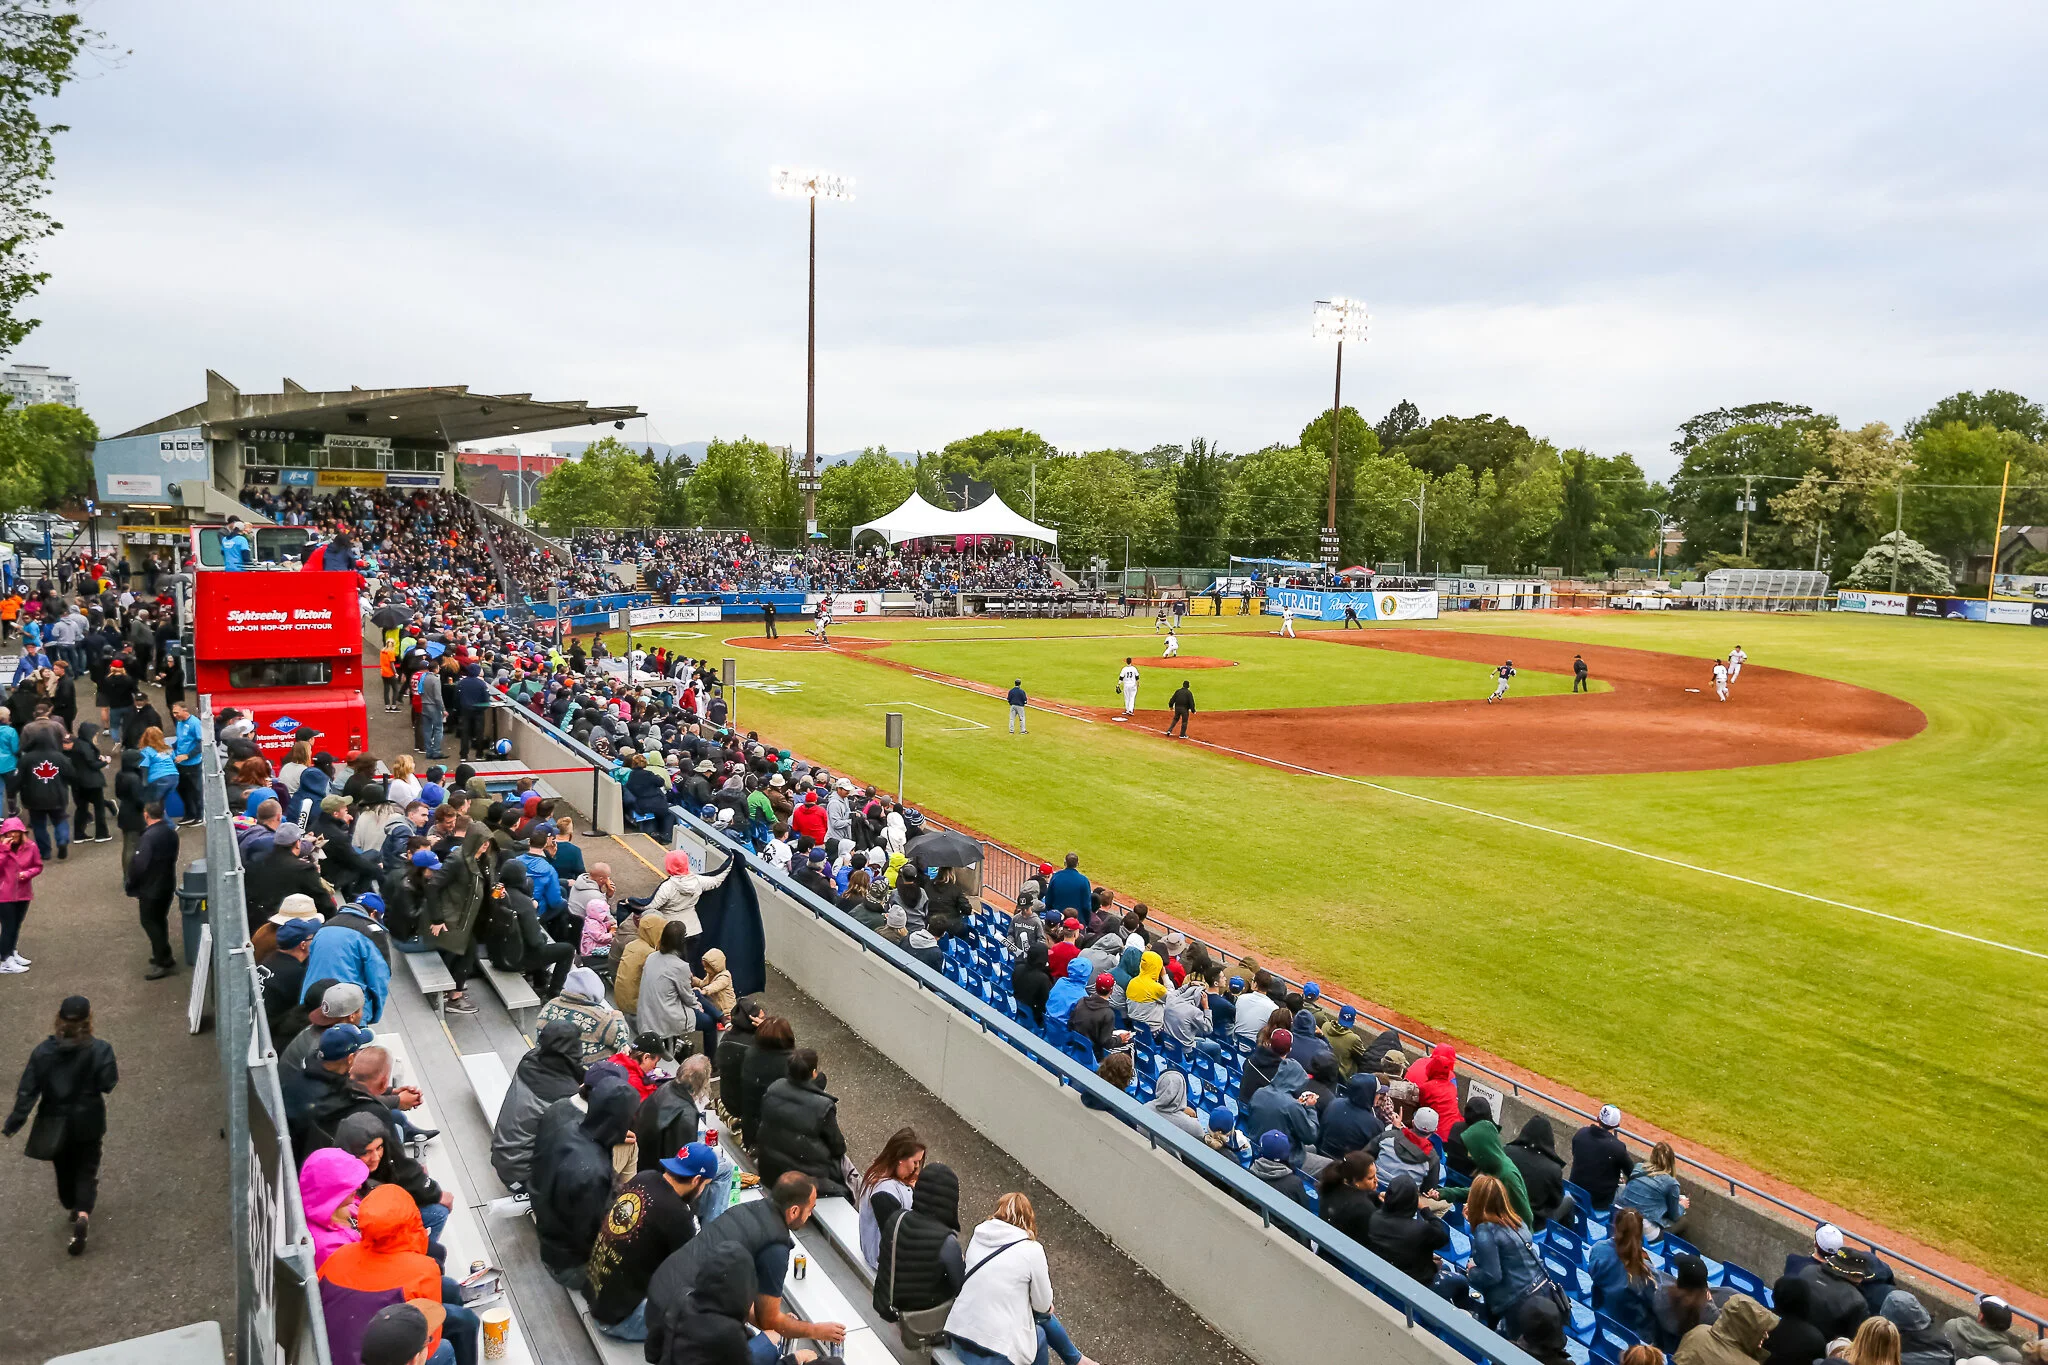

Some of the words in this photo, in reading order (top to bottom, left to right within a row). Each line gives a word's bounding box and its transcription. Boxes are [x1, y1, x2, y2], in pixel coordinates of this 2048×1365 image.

[1278, 592, 1322, 611] STRATH
[227, 610, 288, 624] Sightseeing
[293, 609, 332, 621] Victoria
[1472, 1084, 1495, 1099] Warning!
